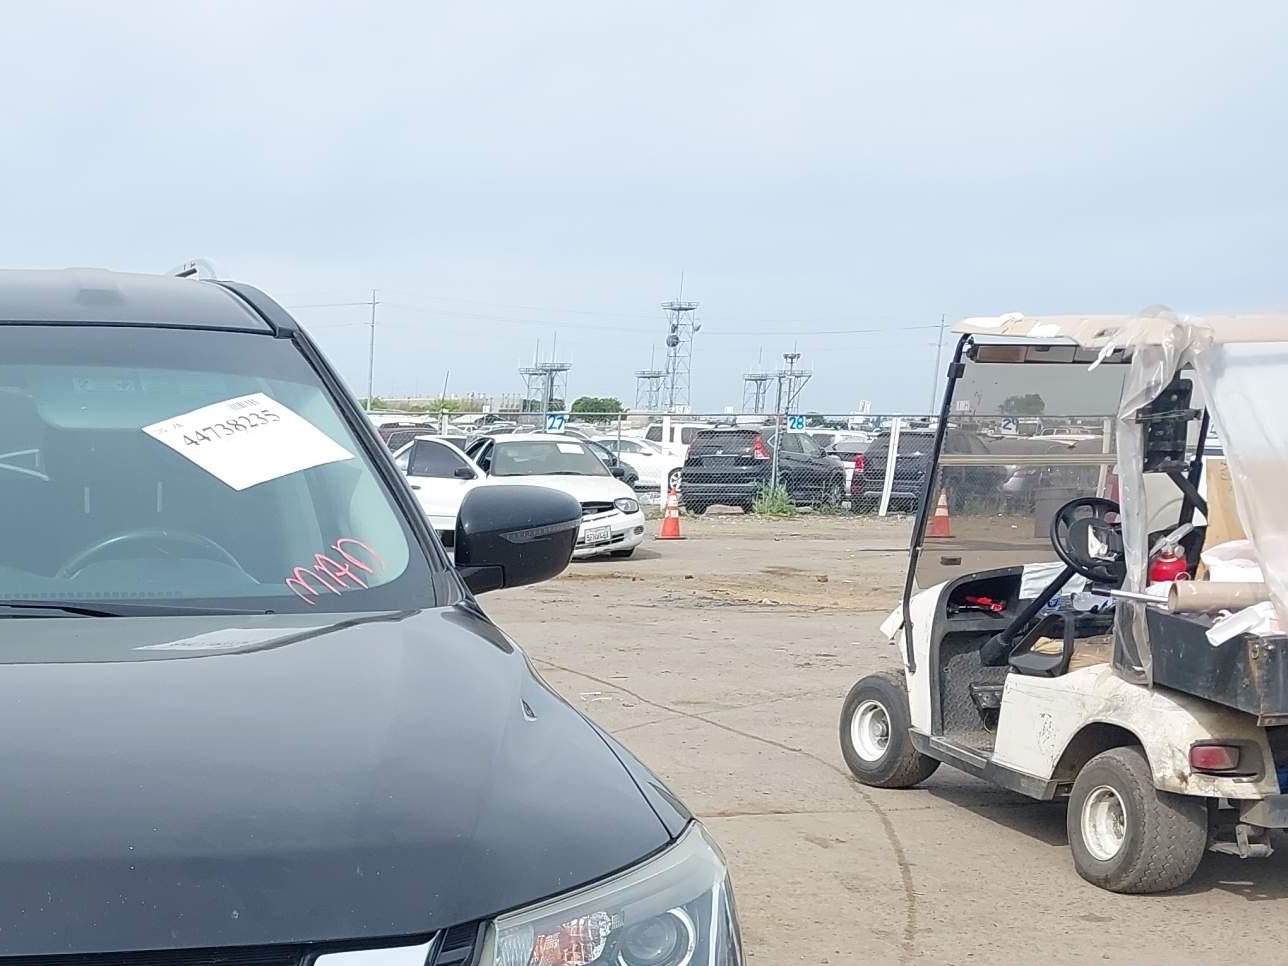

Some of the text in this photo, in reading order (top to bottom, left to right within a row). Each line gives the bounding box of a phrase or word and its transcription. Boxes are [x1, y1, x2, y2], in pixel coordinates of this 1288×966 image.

[183, 410, 280, 446] 44738235
[548, 415, 564, 430] 27
[789, 416, 804, 429] 28
